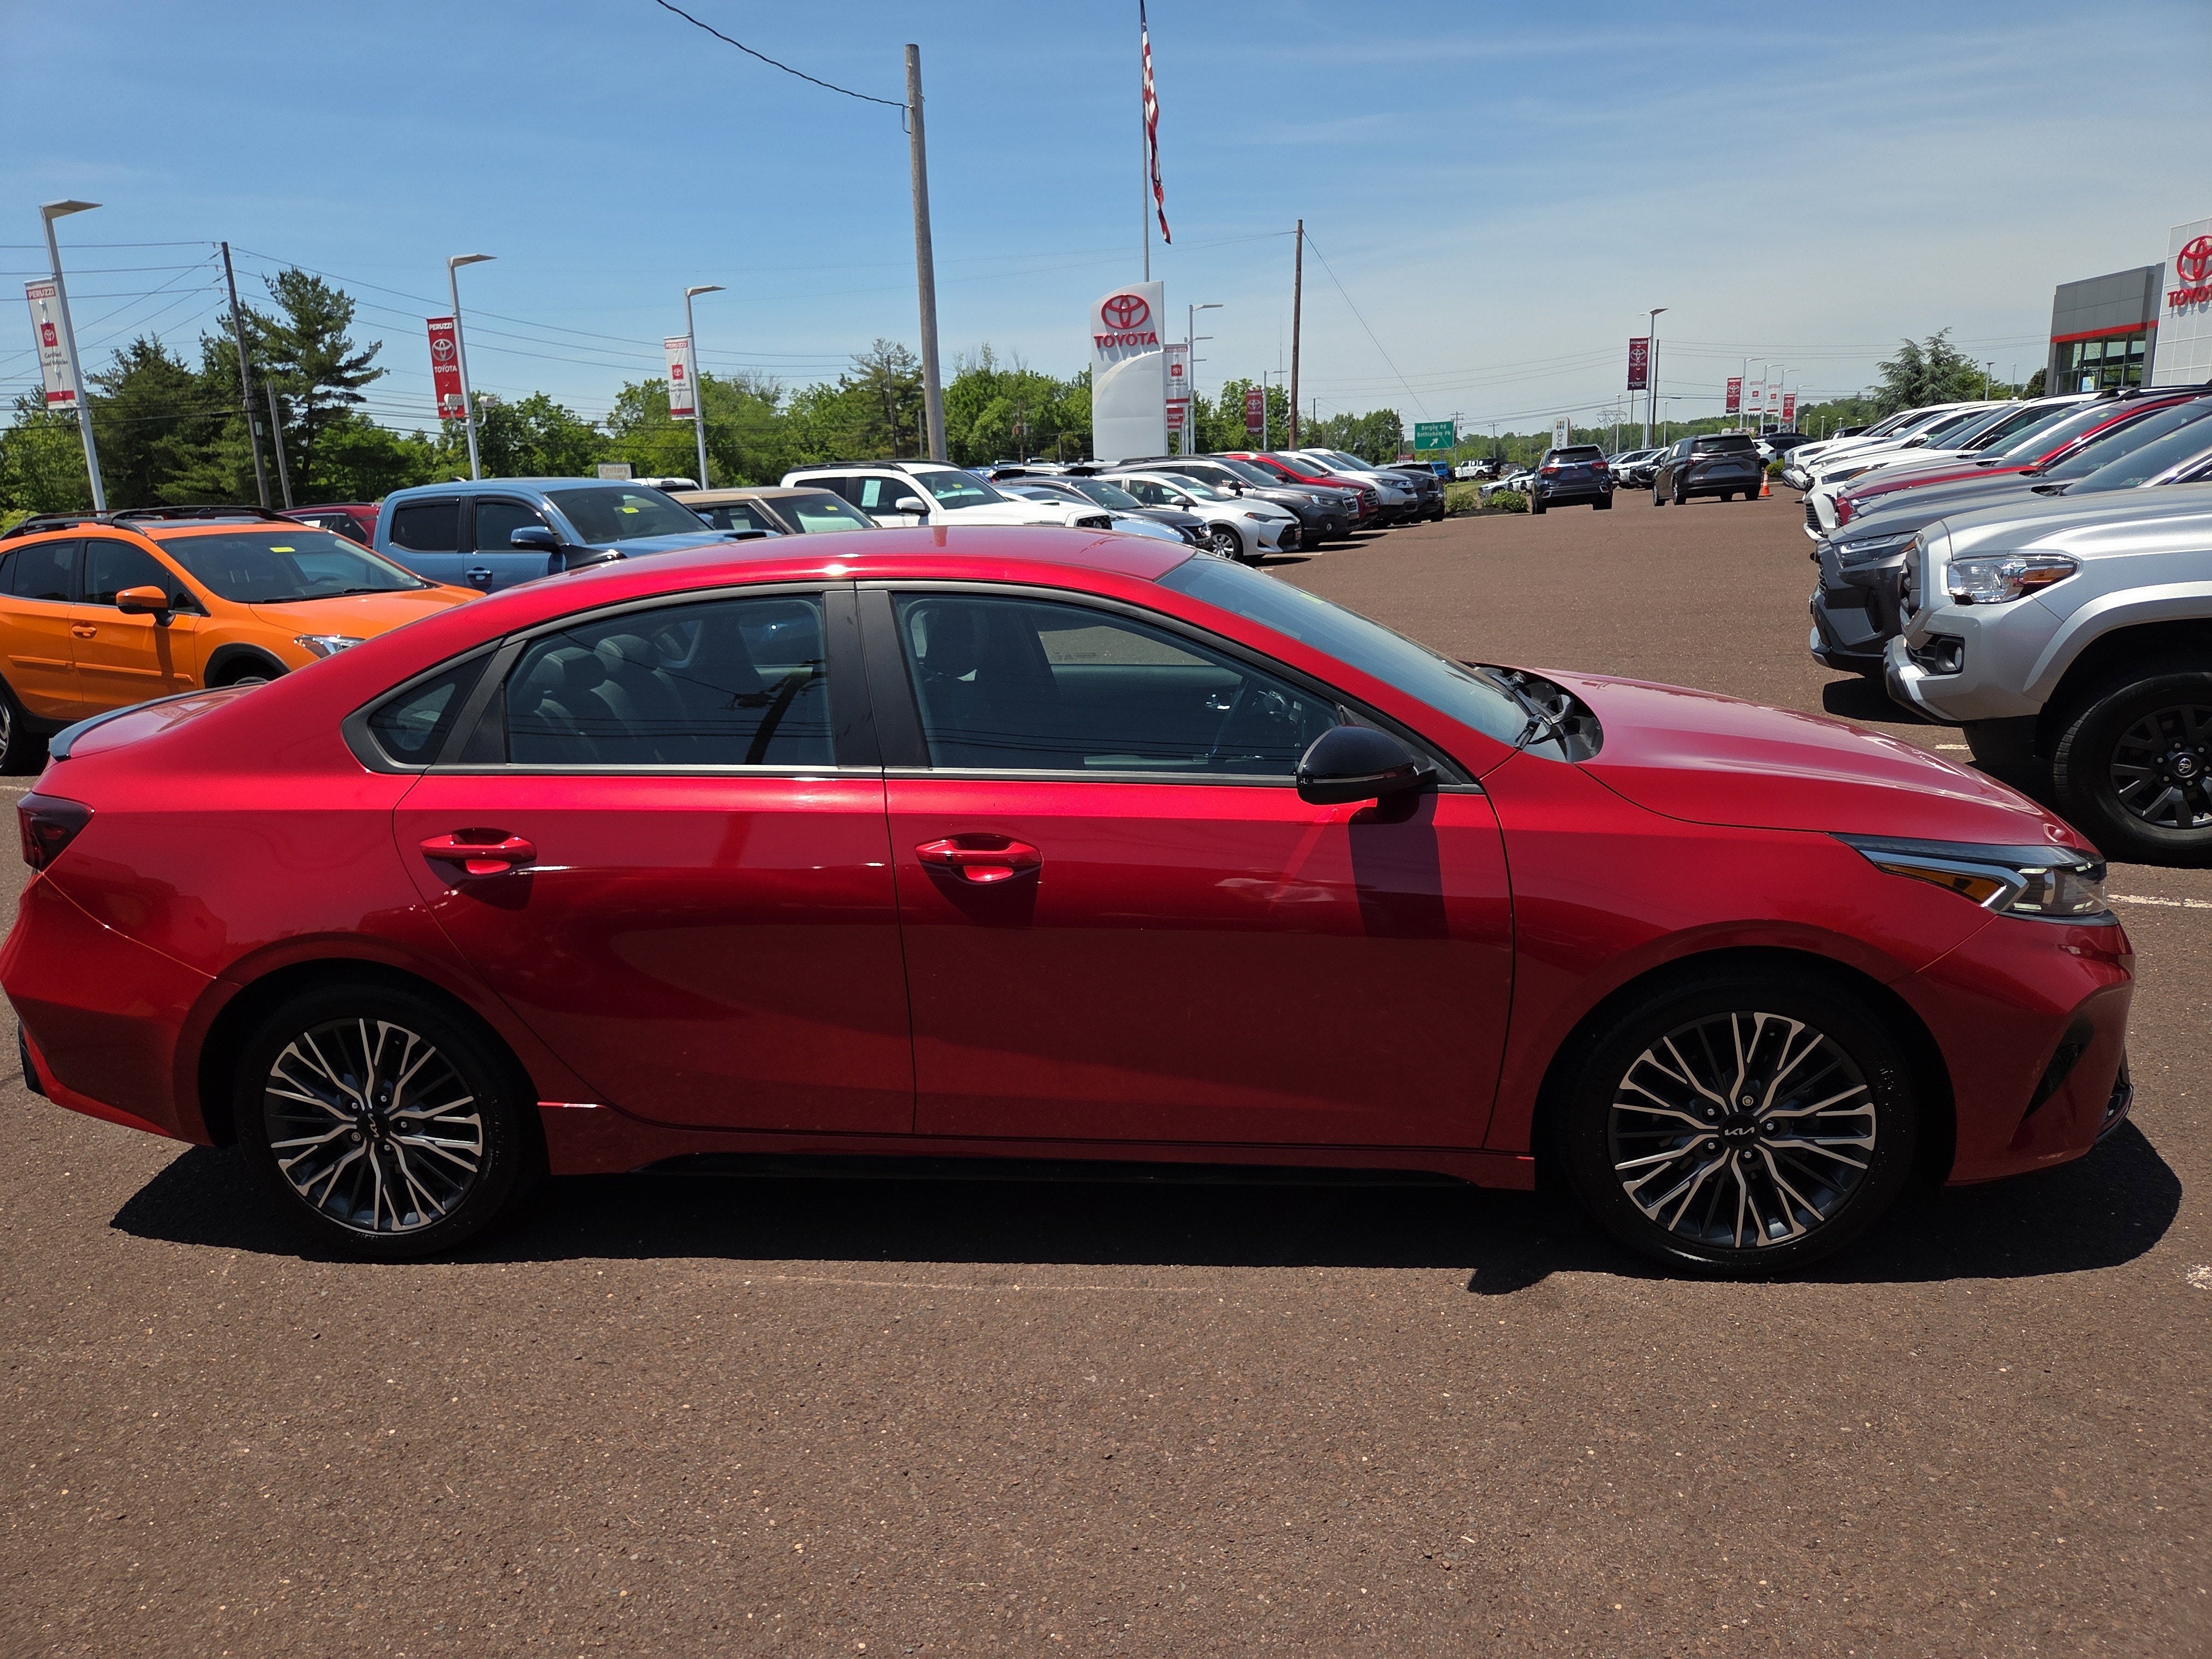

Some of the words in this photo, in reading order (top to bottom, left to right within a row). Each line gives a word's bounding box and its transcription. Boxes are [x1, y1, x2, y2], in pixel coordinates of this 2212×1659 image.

[28, 287, 55, 299] PERUZZI
[1094, 331, 1159, 348] TOYOTA
[434, 365, 458, 373] TOYOTA
